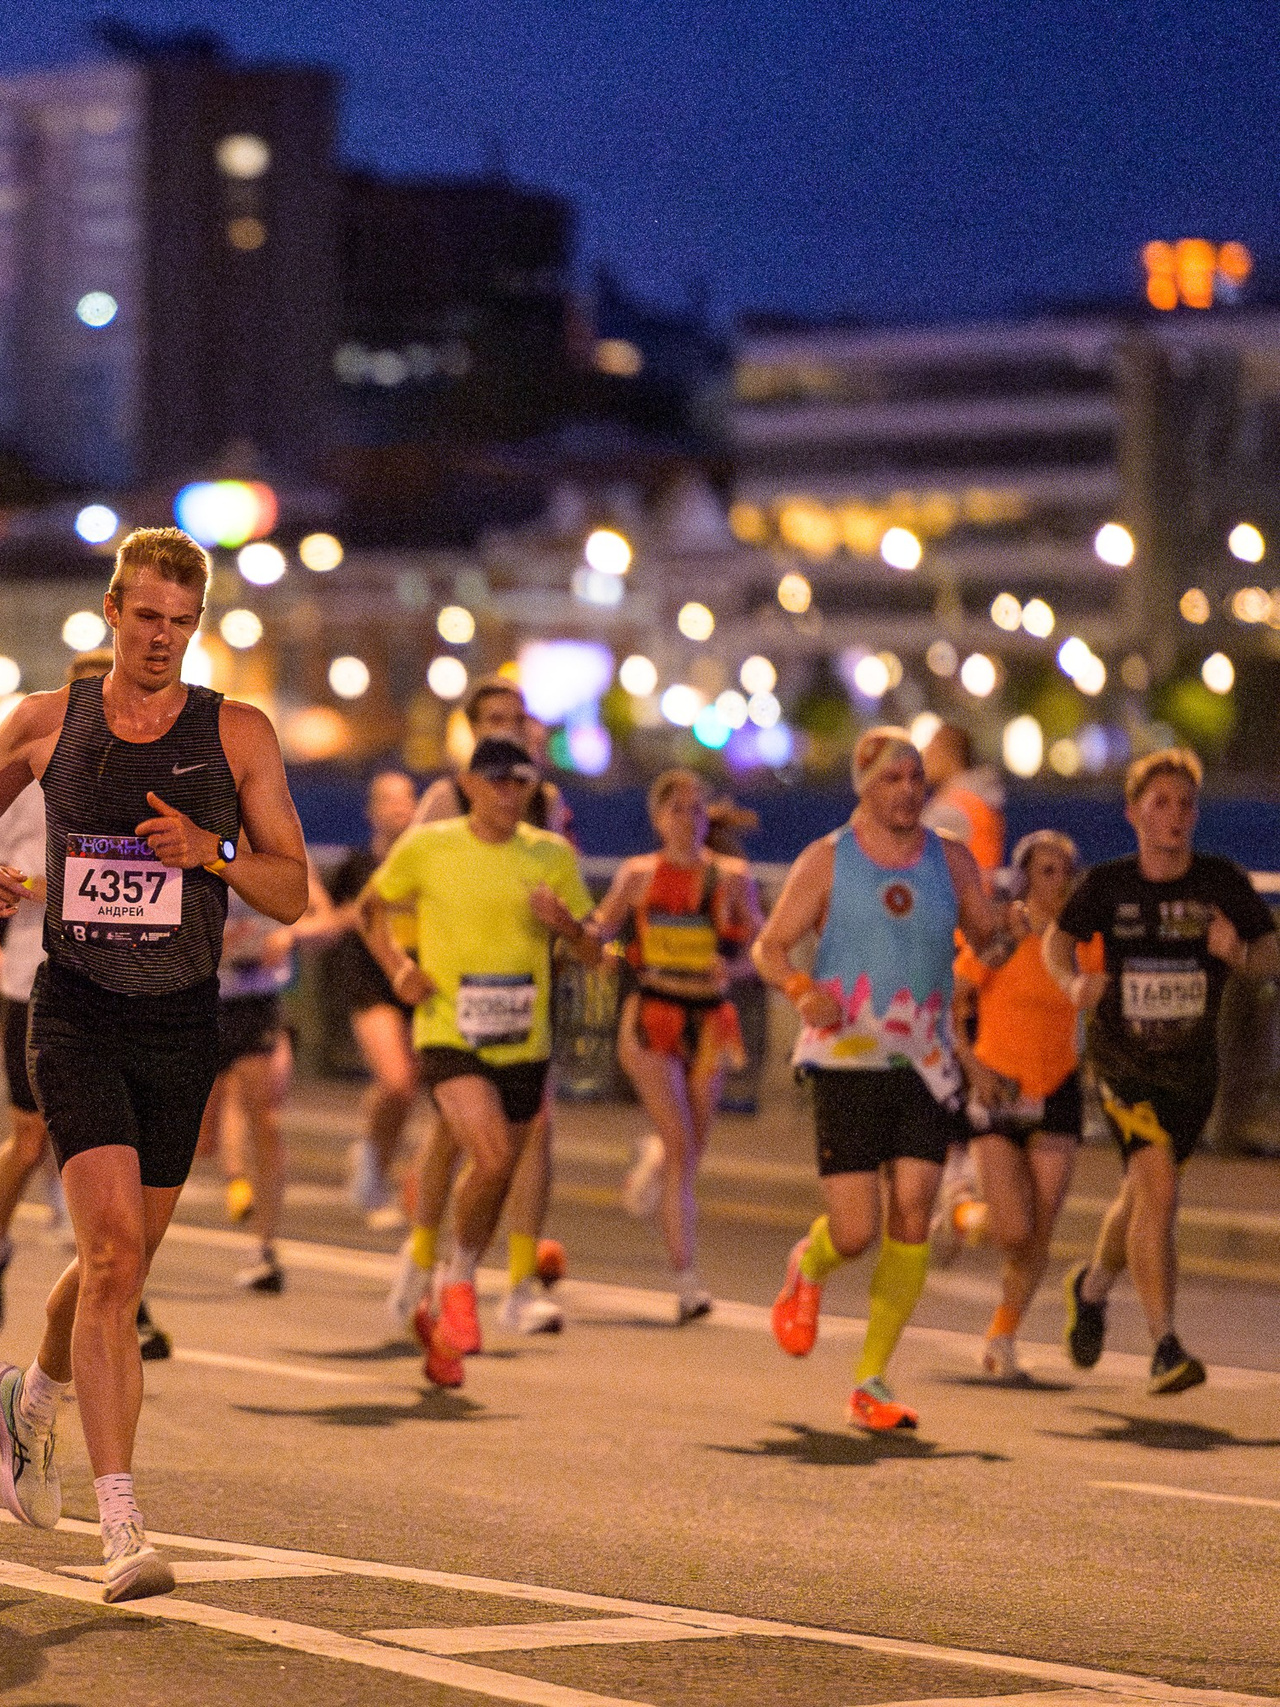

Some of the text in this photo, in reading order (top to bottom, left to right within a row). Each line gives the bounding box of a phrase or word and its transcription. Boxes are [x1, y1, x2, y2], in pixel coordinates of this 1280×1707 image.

[80, 837, 154, 855] НОЧНО
[78, 869, 167, 904] 4357
[98, 906, 144, 917] АНДРЕЙ
